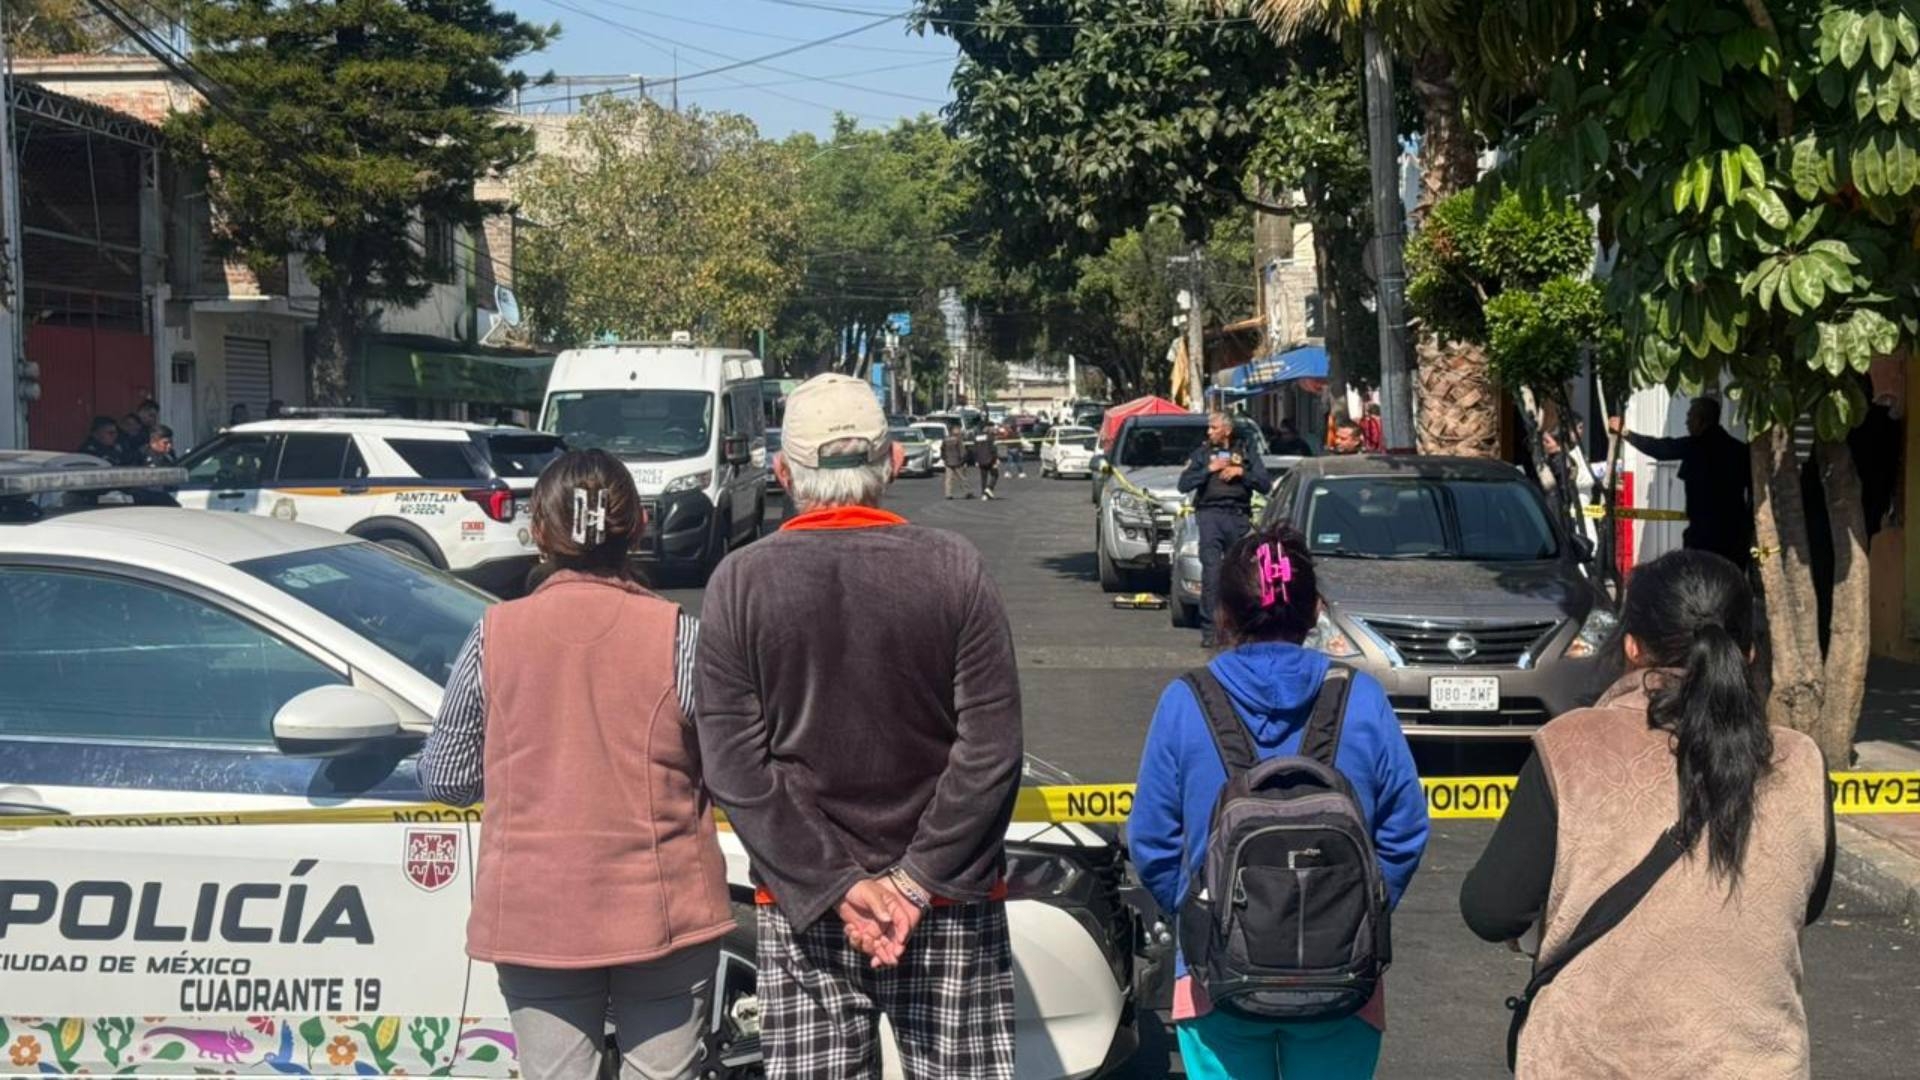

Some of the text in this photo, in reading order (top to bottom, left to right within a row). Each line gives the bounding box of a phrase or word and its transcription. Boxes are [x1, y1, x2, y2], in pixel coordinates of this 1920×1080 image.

[395, 492, 458, 502] PANTITLAN
[1067, 791, 1133, 818] CION
[0, 859, 374, 944] POLICÍA
[0, 951, 251, 975] IUDAD DE MÉXICO
[180, 978, 381, 1012] CUADRANTE 19
